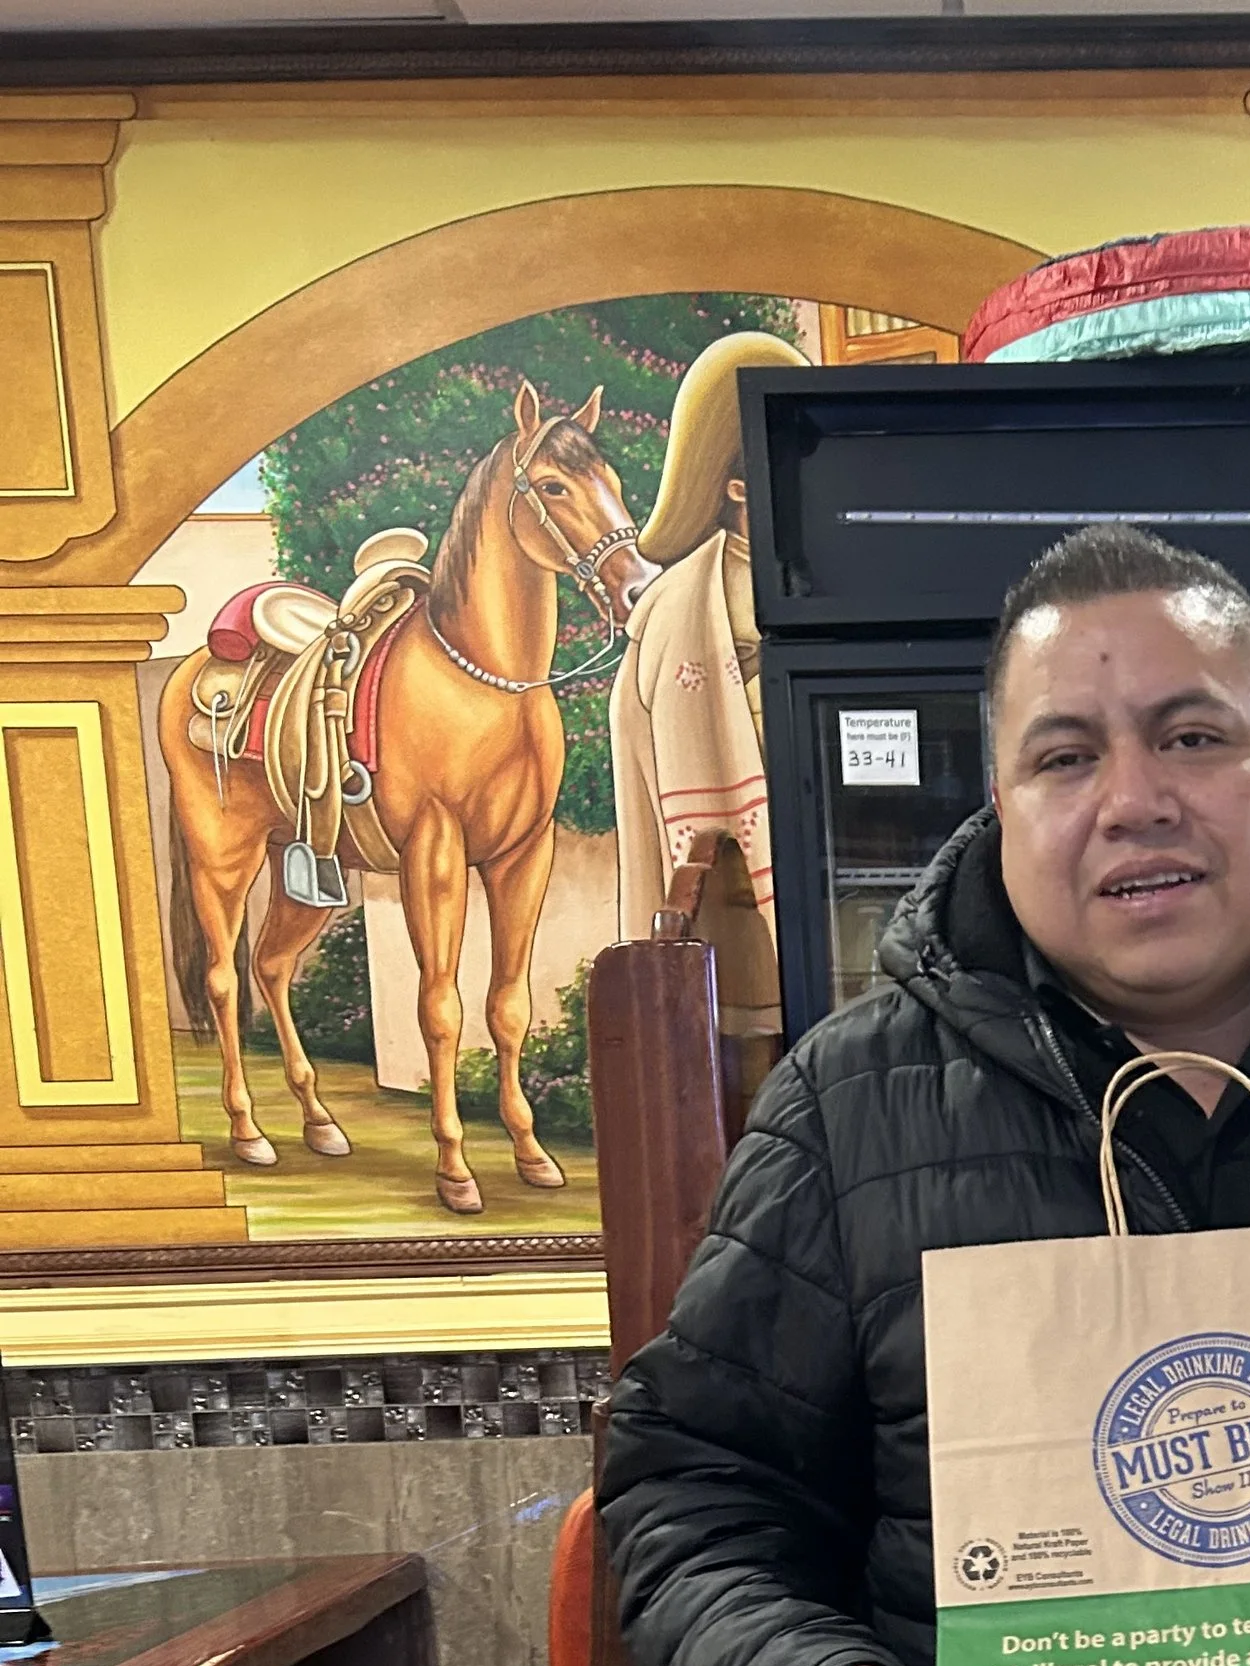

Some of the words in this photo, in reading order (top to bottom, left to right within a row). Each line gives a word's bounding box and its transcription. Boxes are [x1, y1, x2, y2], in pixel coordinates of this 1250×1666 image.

[845, 717, 911, 729] Temperature
[848, 750, 905, 768] 33-41
[1120, 1379, 1166, 1426] LEGAL
[1161, 1353, 1245, 1385] DRINKING
[1167, 1405, 1226, 1426] Prepare
[1231, 1400, 1246, 1411] to
[1112, 1431, 1213, 1490] MUST
[1192, 1478, 1234, 1500] Show
[1150, 1509, 1200, 1548] LEGAL
[1002, 1631, 1070, 1654] Don't
[1075, 1630, 1105, 1650] be
[1112, 1633, 1125, 1647] a
[1130, 1624, 1196, 1650] party
[1201, 1622, 1227, 1639] to
